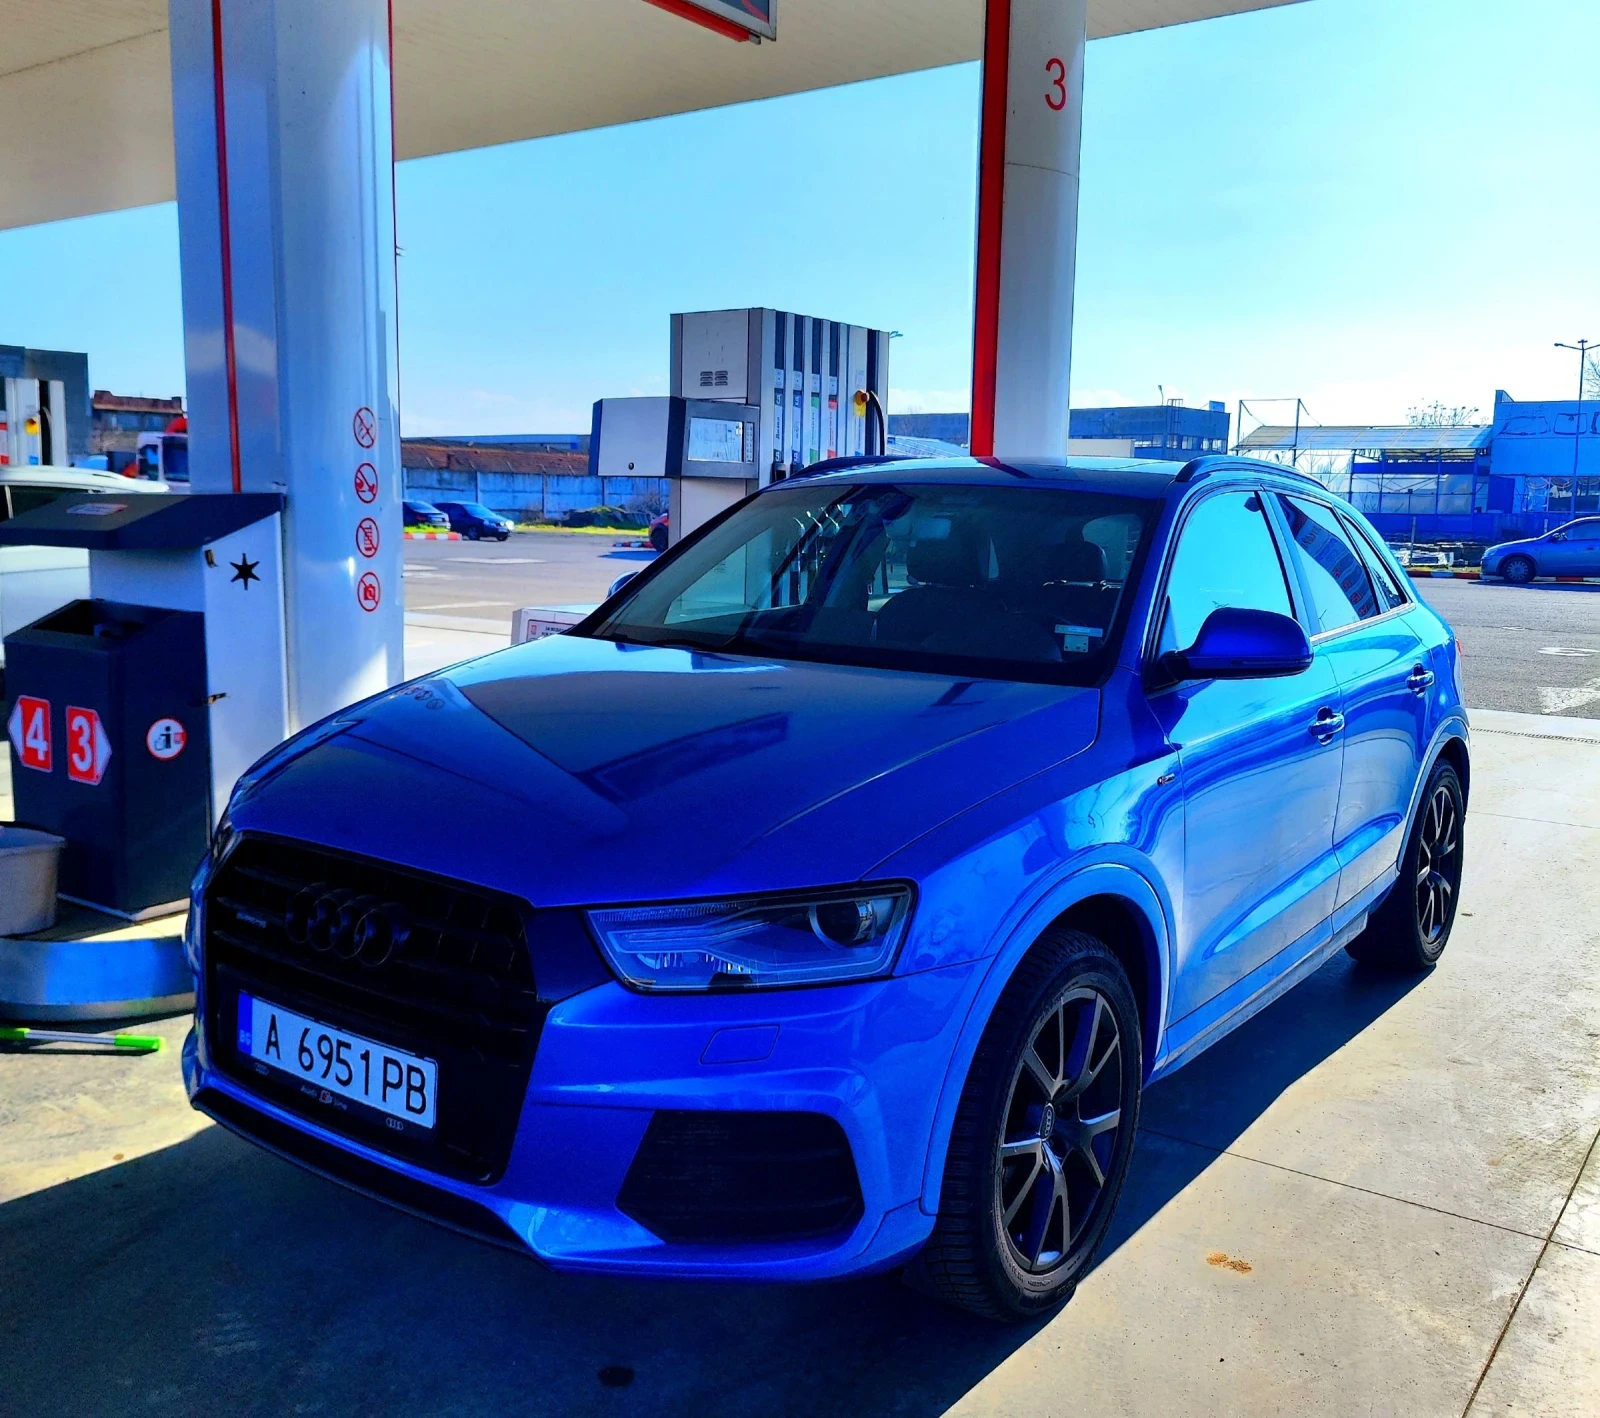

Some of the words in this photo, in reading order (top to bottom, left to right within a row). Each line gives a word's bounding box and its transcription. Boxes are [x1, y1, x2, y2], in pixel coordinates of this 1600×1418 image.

[1045, 57, 1067, 111] 3
[26, 707, 48, 761] 4
[71, 715, 93, 772] 3
[265, 1013, 281, 1060] A
